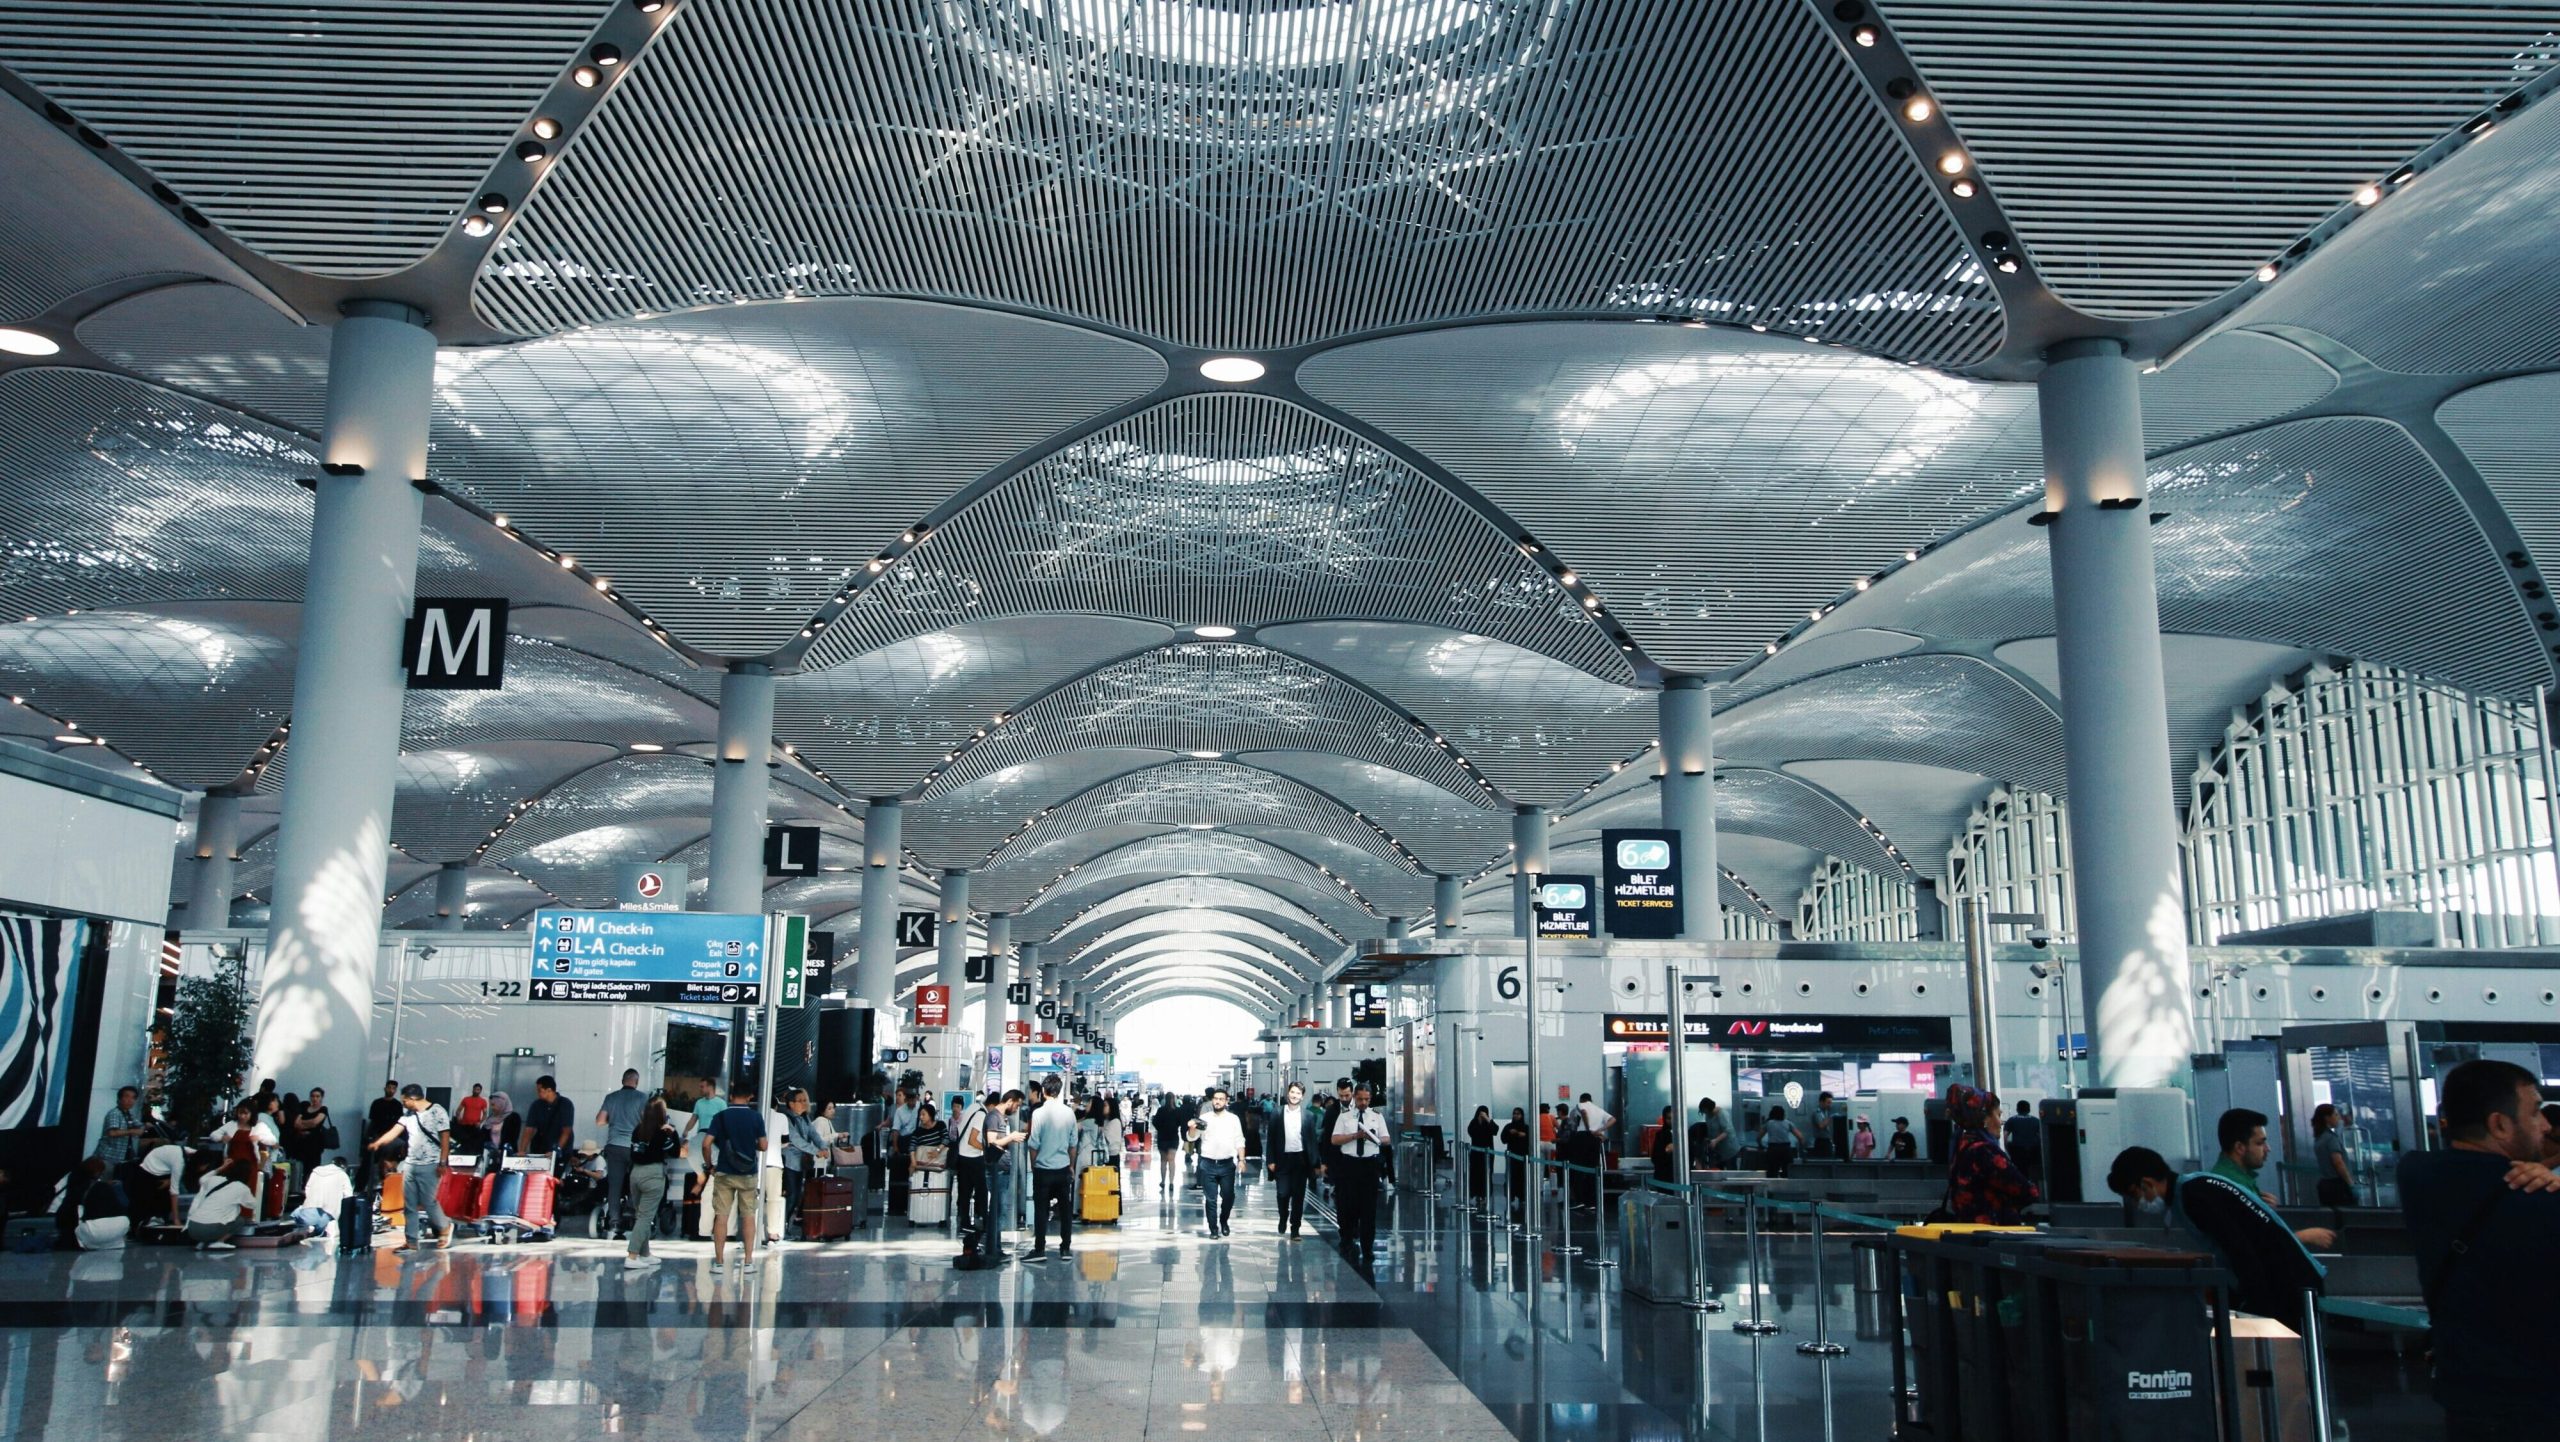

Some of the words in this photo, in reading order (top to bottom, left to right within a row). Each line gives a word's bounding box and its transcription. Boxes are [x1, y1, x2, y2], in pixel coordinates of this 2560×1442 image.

[416, 608, 492, 676] M
[780, 832, 803, 870] L
[1622, 843, 1639, 866] 6
[1630, 873, 1658, 885] BİLET
[1614, 884, 1675, 896] HİZMETLERİ
[1546, 887, 1560, 905] 6
[620, 902, 679, 911] Miles&Smiles
[1616, 900, 1641, 908] TICKET
[1641, 900, 1674, 908] SERVICES
[1552, 911, 1576, 921] BİLET
[576, 917, 594, 934] M
[599, 922, 653, 935] Check-in
[905, 916, 926, 943] K
[1540, 921, 1590, 930] HİZMETLERİ
[574, 937, 605, 954] L-A
[609, 943, 664, 956] Check-in
[575, 957, 590, 966] Tüm
[591, 958, 608, 967] gidiş
[692, 960, 721, 969] Otopark
[806, 959, 825, 968] NESS
[573, 967, 583, 975] All
[583, 968, 604, 976] gates
[703, 970, 721, 979] park
[975, 959, 987, 980] J
[571, 982, 590, 991] Vergi
[634, 983, 651, 992] THY)
[687, 983, 703, 991] Bilet
[1497, 965, 1521, 999] 6
[481, 981, 522, 997] 1-22
[1012, 985, 1027, 1002] H
[571, 991, 582, 999] Tax
[583, 991, 596, 999] free
[597, 992, 609, 1000] (TK
[609, 992, 627, 1000] only)
[1040, 1003, 1053, 1018] G
[1061, 1015, 1069, 1027] F
[1076, 1025, 1084, 1036] E
[1661, 1022, 1710, 1032] TVEL
[1769, 1022, 1823, 1033] Nordwind
[1087, 1032, 1096, 1041] D
[912, 1036, 927, 1054] K
[1097, 1039, 1104, 1048] C
[1316, 1040, 1326, 1056] 5
[1266, 1060, 1273, 1070] 4
[2206, 1178, 2240, 1195] GROUP
